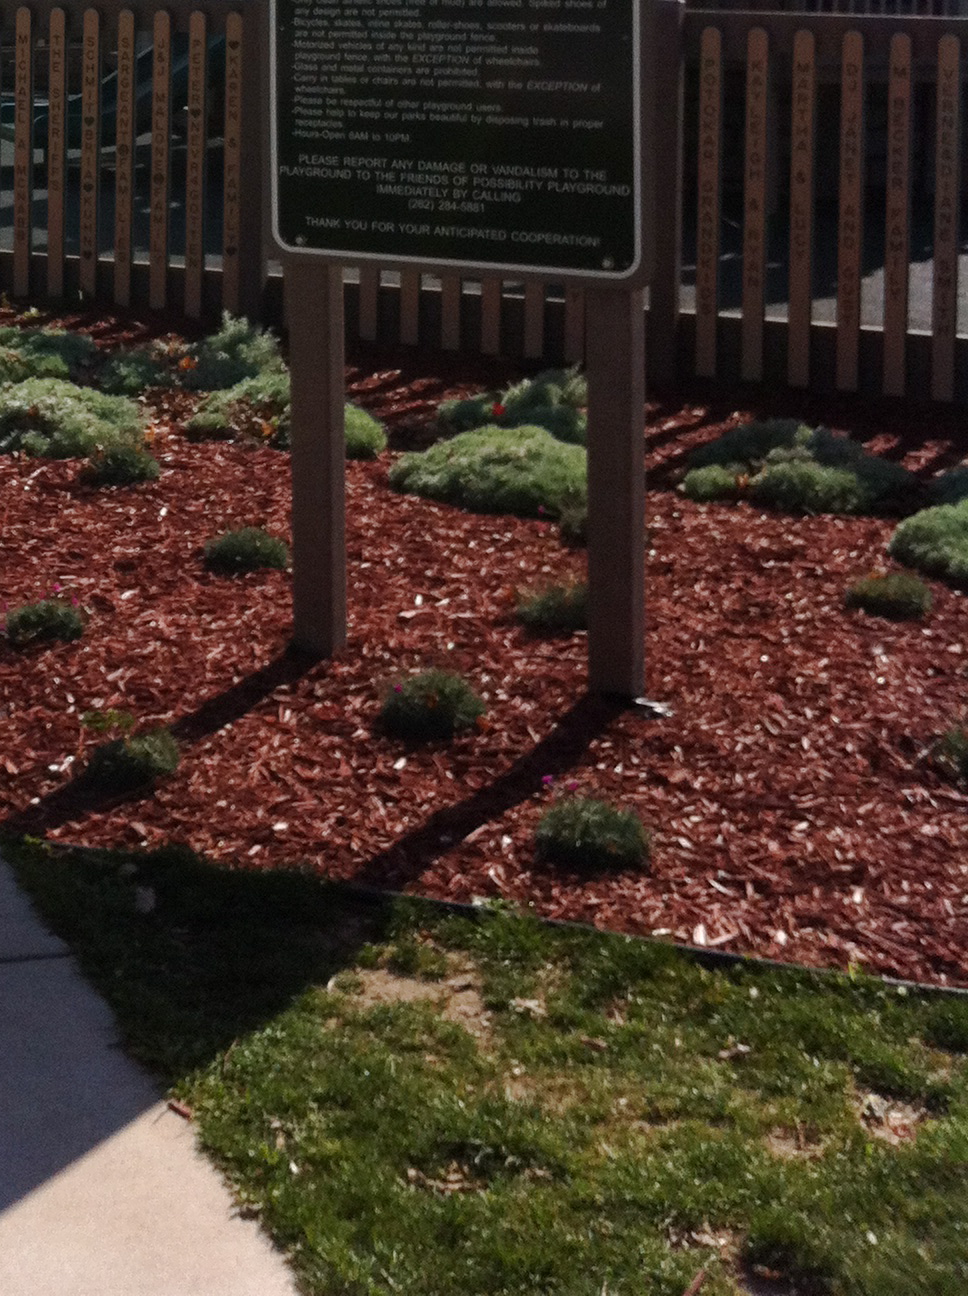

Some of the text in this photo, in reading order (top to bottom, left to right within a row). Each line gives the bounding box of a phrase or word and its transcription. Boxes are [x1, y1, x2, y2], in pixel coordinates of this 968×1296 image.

[276, 164, 631, 196] PLAYGROUND TO THE FRIENDS OF POSSIBILITY PLAYGROUND
[298, 153, 606, 181] PLEASE REPORT ANY DAMAGE OR VANDALISM TO THE
[376, 183, 520, 203] IMMEDIATELY BY CALLING
[305, 215, 340, 228] THANK
[344, 218, 367, 230] YOU
[371, 220, 394, 232] FOR
[398, 222, 430, 235] YOUR
[433, 224, 506, 240] ANTICIPATED
